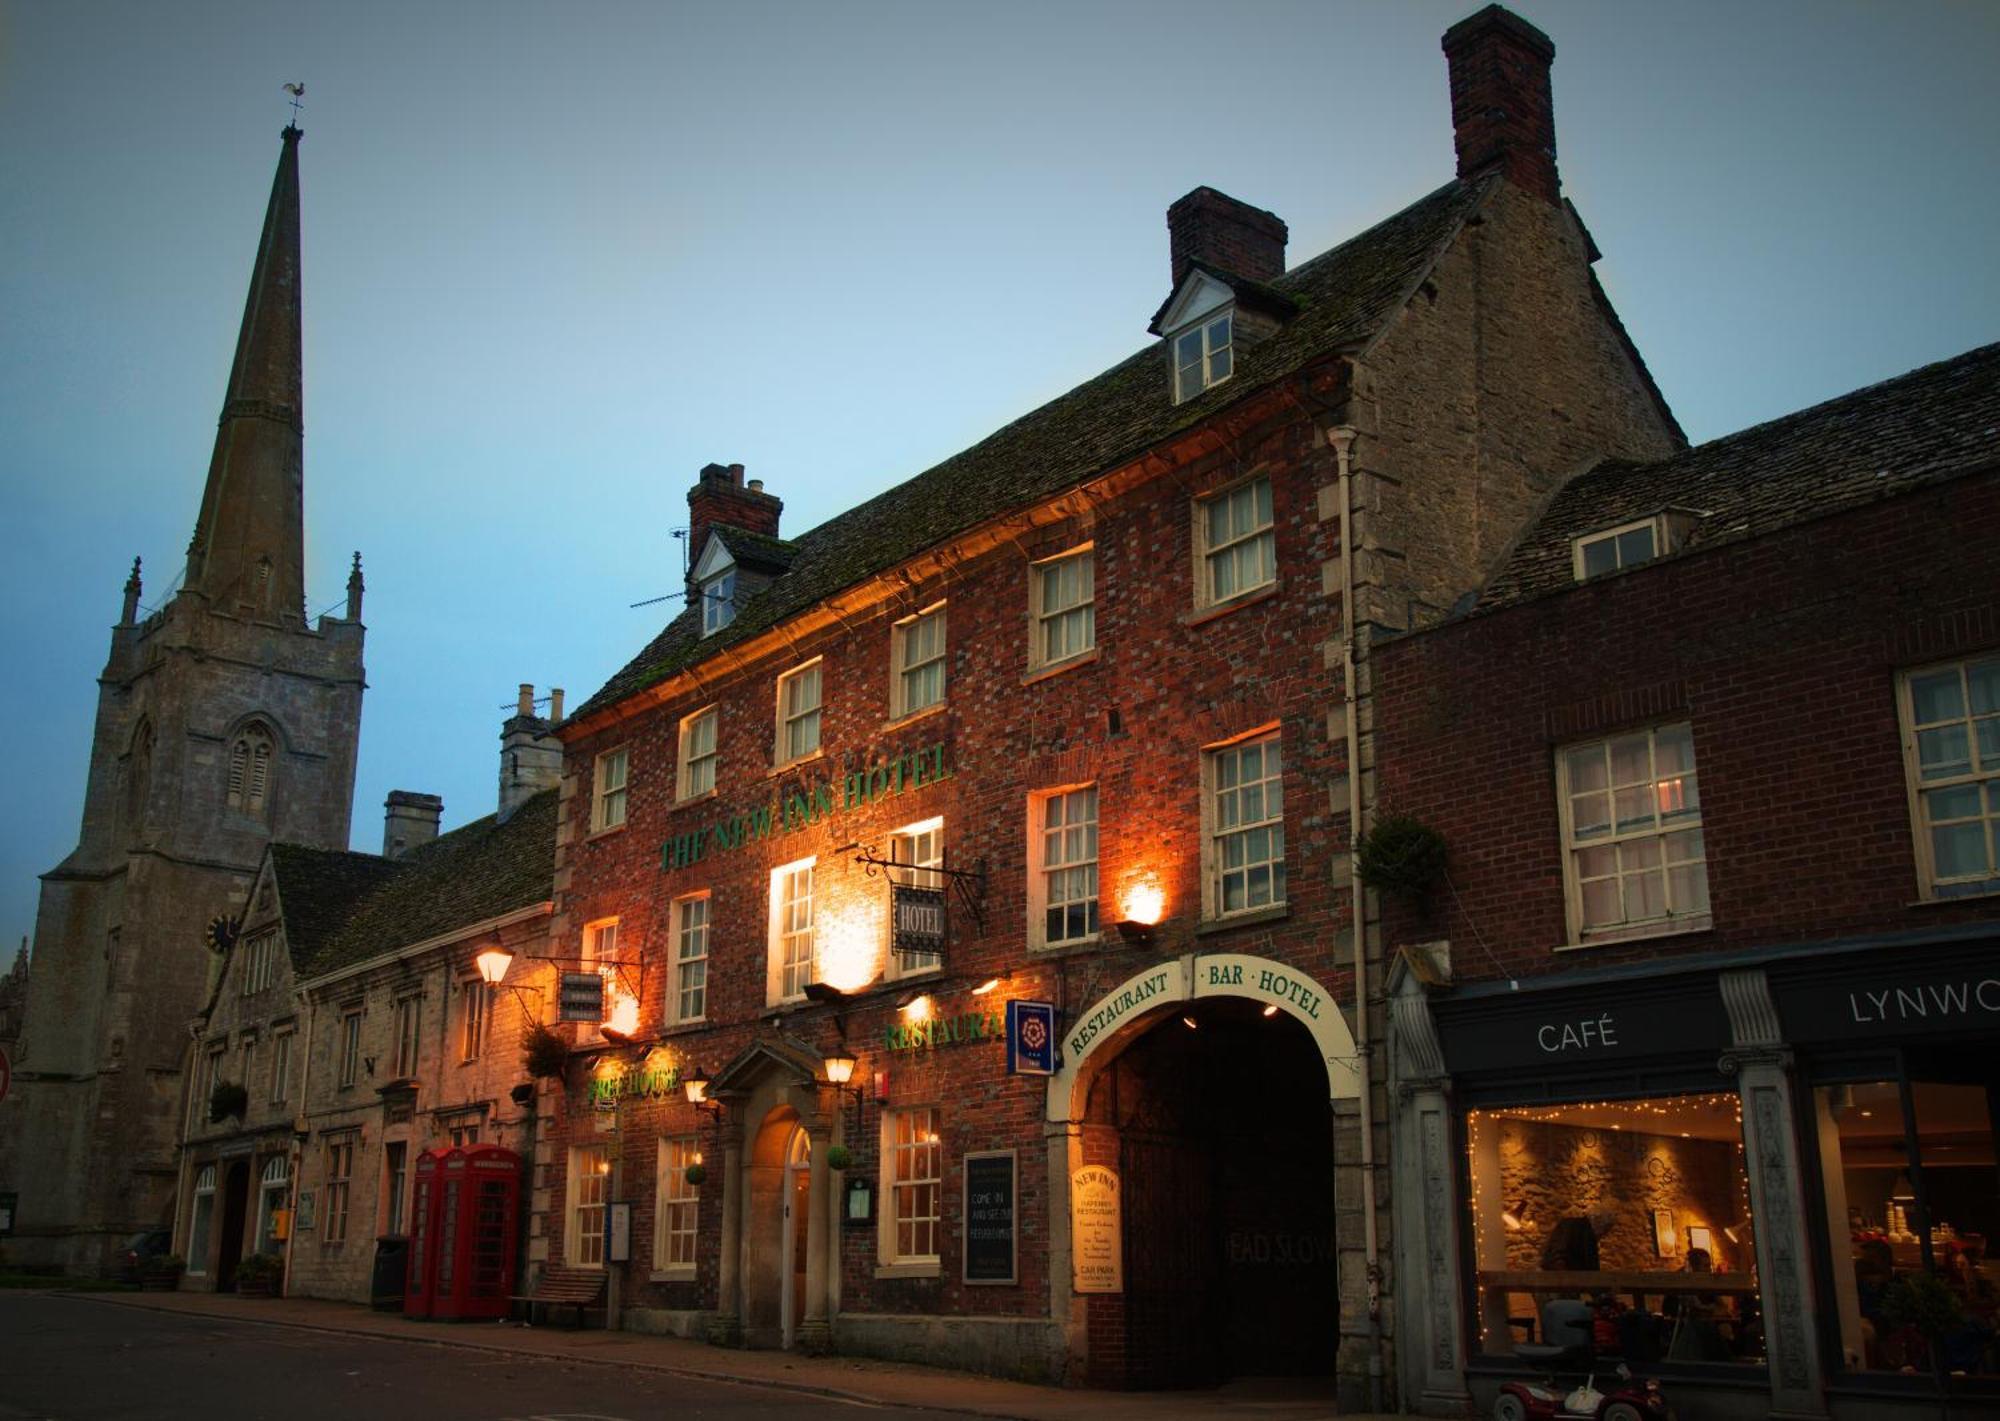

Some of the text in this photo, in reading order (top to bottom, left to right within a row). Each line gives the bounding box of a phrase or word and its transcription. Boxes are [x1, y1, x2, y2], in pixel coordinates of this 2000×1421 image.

[661, 743, 953, 872] THE NEW INN HOTEL
[900, 904, 942, 934] HOTEL
[1071, 965, 1321, 1056] RESTAURANT BAR HOTEL
[885, 1012, 1005, 1051] RESTAURA
[1538, 1012, 1618, 1052] CAFÉ
[627, 1067, 680, 1097] HOUSE
[1075, 1171, 1116, 1192] NEW INN
